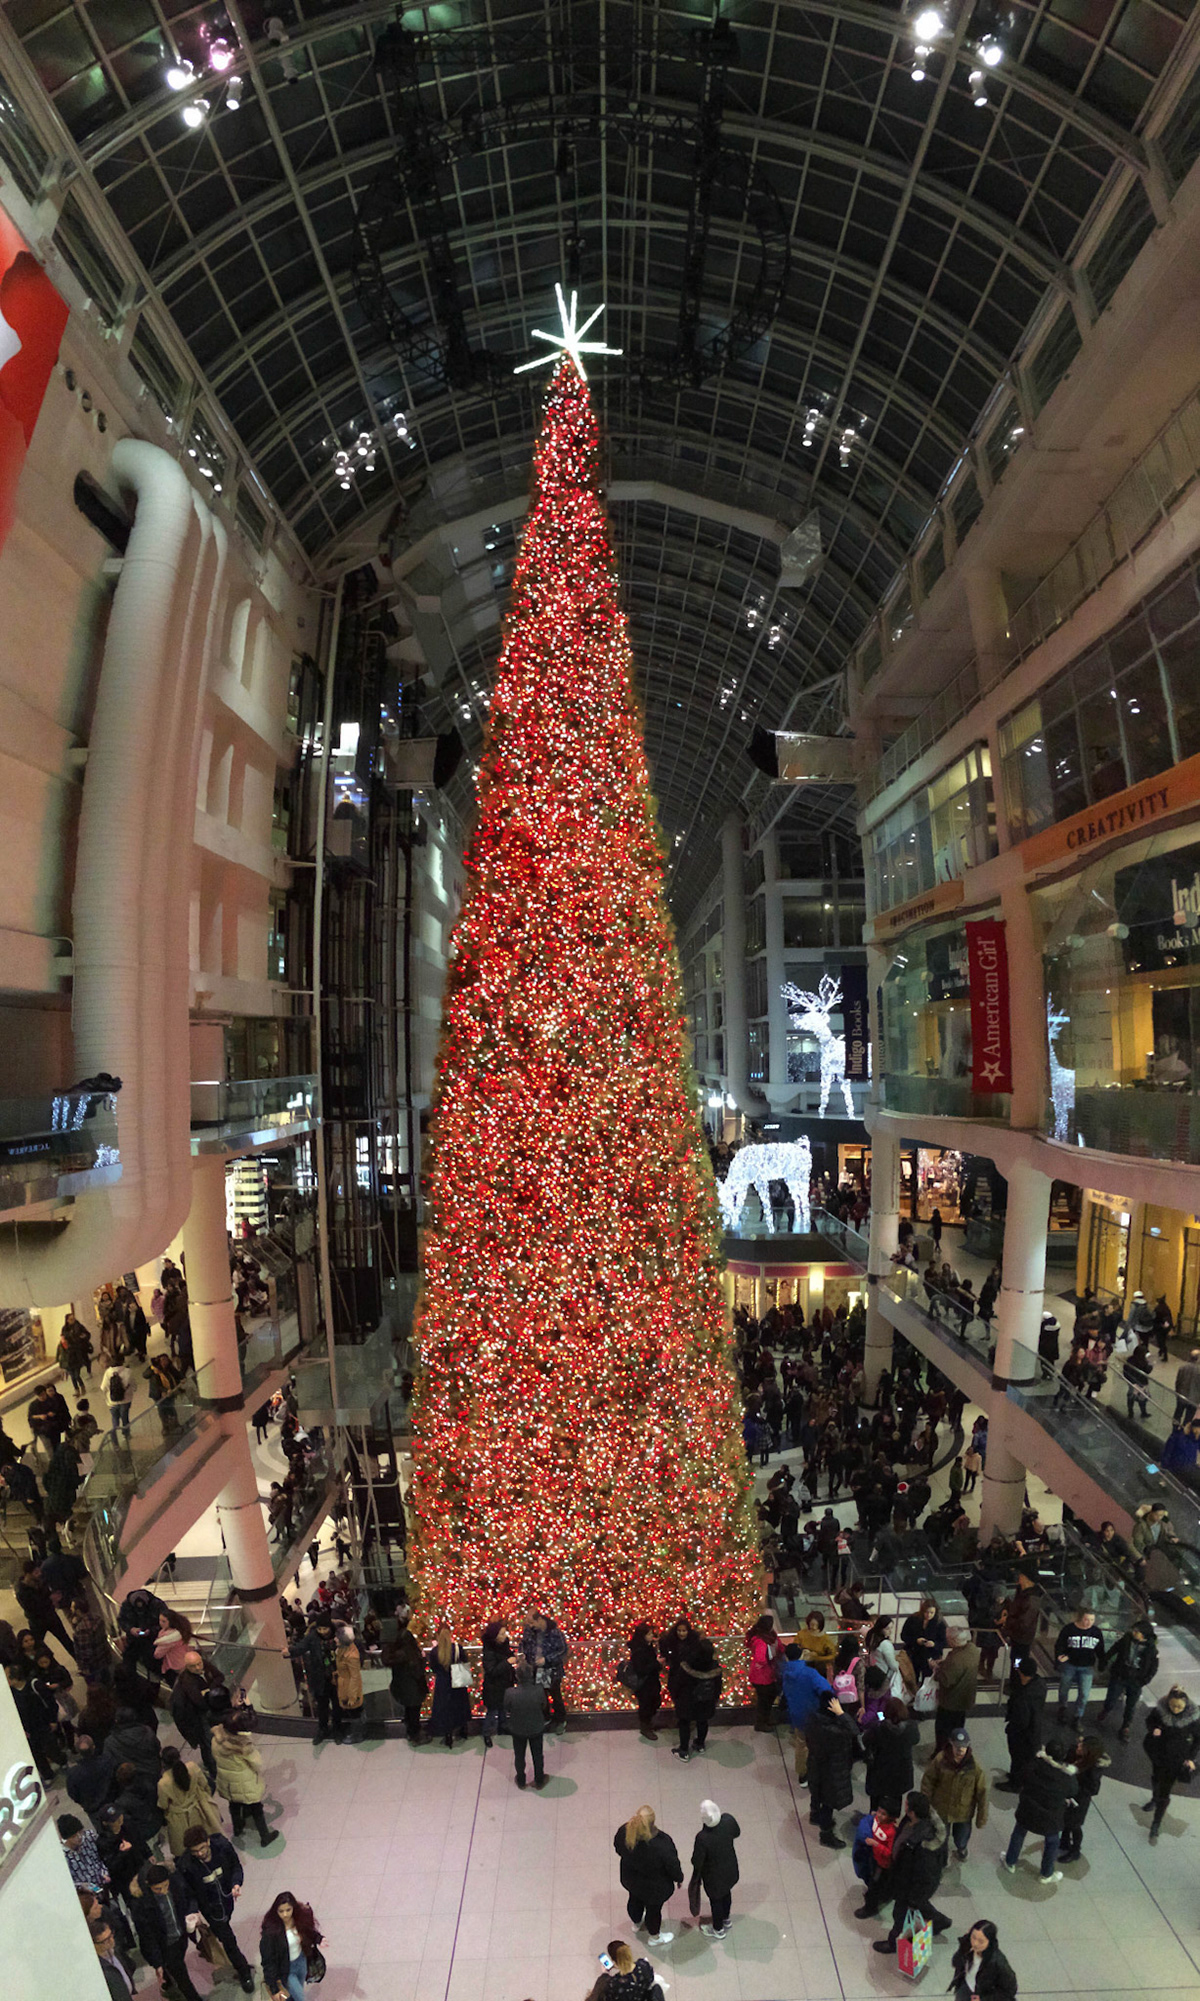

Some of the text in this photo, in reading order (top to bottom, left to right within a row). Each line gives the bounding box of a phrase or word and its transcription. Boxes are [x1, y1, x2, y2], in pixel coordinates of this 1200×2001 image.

[1066, 787, 1168, 849] CREATIVITY
[1157, 930, 1190, 950] Books
[977, 939, 1001, 1058] American Girl
[848, 1000, 865, 1074] Indigo Books
